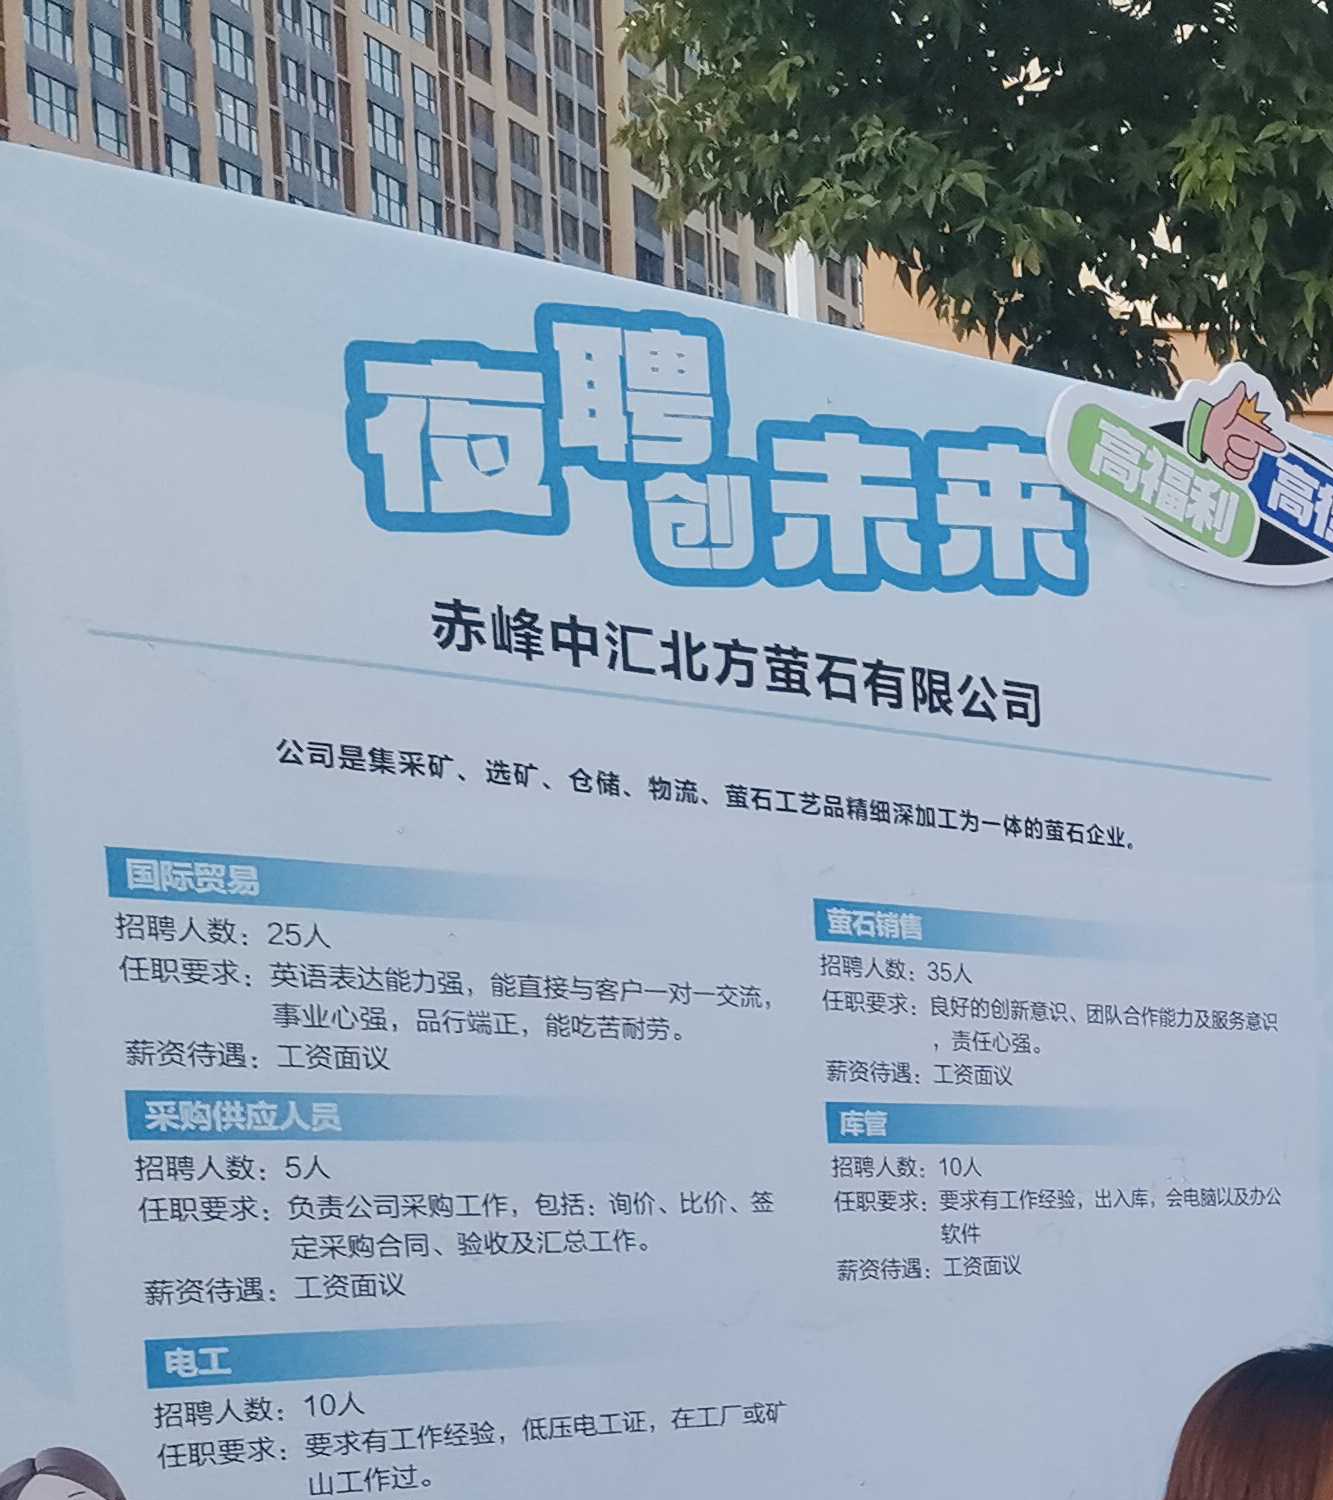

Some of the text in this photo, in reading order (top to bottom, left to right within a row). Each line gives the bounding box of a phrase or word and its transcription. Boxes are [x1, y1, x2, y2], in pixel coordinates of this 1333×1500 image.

[350, 308, 1086, 591] 夜聘创未来
[1089, 417, 1242, 545] 高福利
[430, 596, 1042, 729] 赤峰中汇北方萤石有限公司
[126, 857, 260, 898] 国际贸易
[115, 913, 331, 950] 招聘人数：25人
[826, 906, 924, 941] 萤石销售
[819, 954, 973, 984] 招聘人数：35人
[125, 1040, 391, 1072] 薪资待遇：工资面议
[826, 1060, 1014, 1087] 薪资待遇：工资面议
[145, 1100, 343, 1134] 采购供应人员
[840, 1110, 889, 1138] 库管
[135, 1154, 331, 1183] 招聘人数：5人
[832, 1155, 982, 1180] 招聘人数：10人
[940, 1222, 982, 1245] 软件
[836, 1254, 1022, 1282] 薪资待遇：工资面议
[145, 1271, 407, 1307] 薪资待遇：工资面议
[163, 1346, 232, 1379] 电工
[154, 1391, 365, 1430] 招聘人数：10人
[307, 1463, 440, 1498] 山工作过。
